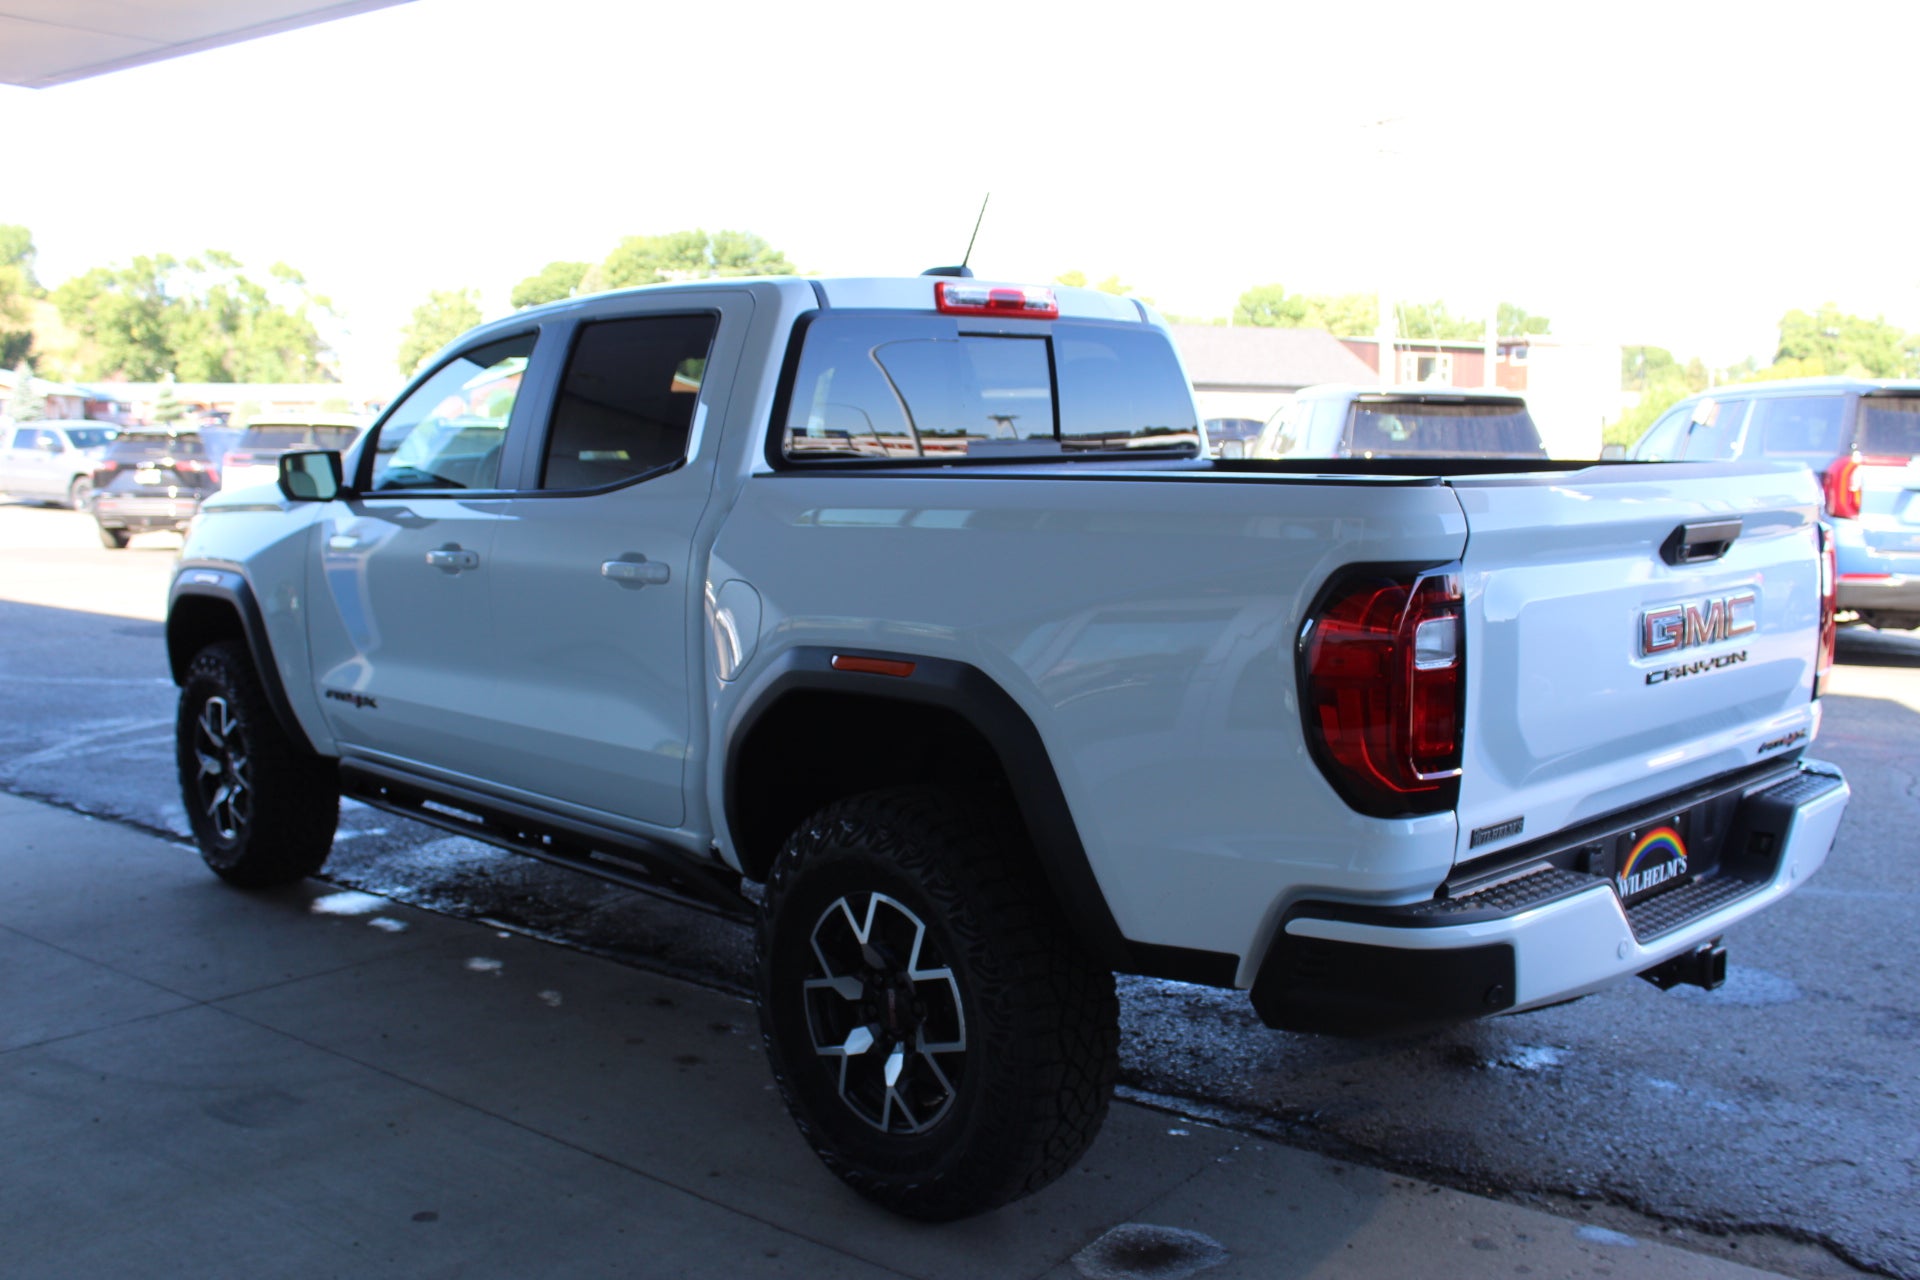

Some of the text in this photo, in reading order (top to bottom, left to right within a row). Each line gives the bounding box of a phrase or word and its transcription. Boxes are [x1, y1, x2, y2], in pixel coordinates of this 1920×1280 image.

[1642, 592, 1756, 656] GMC
[1645, 650, 1748, 685] CANYON
[1616, 855, 1687, 898] WILHELM'S
